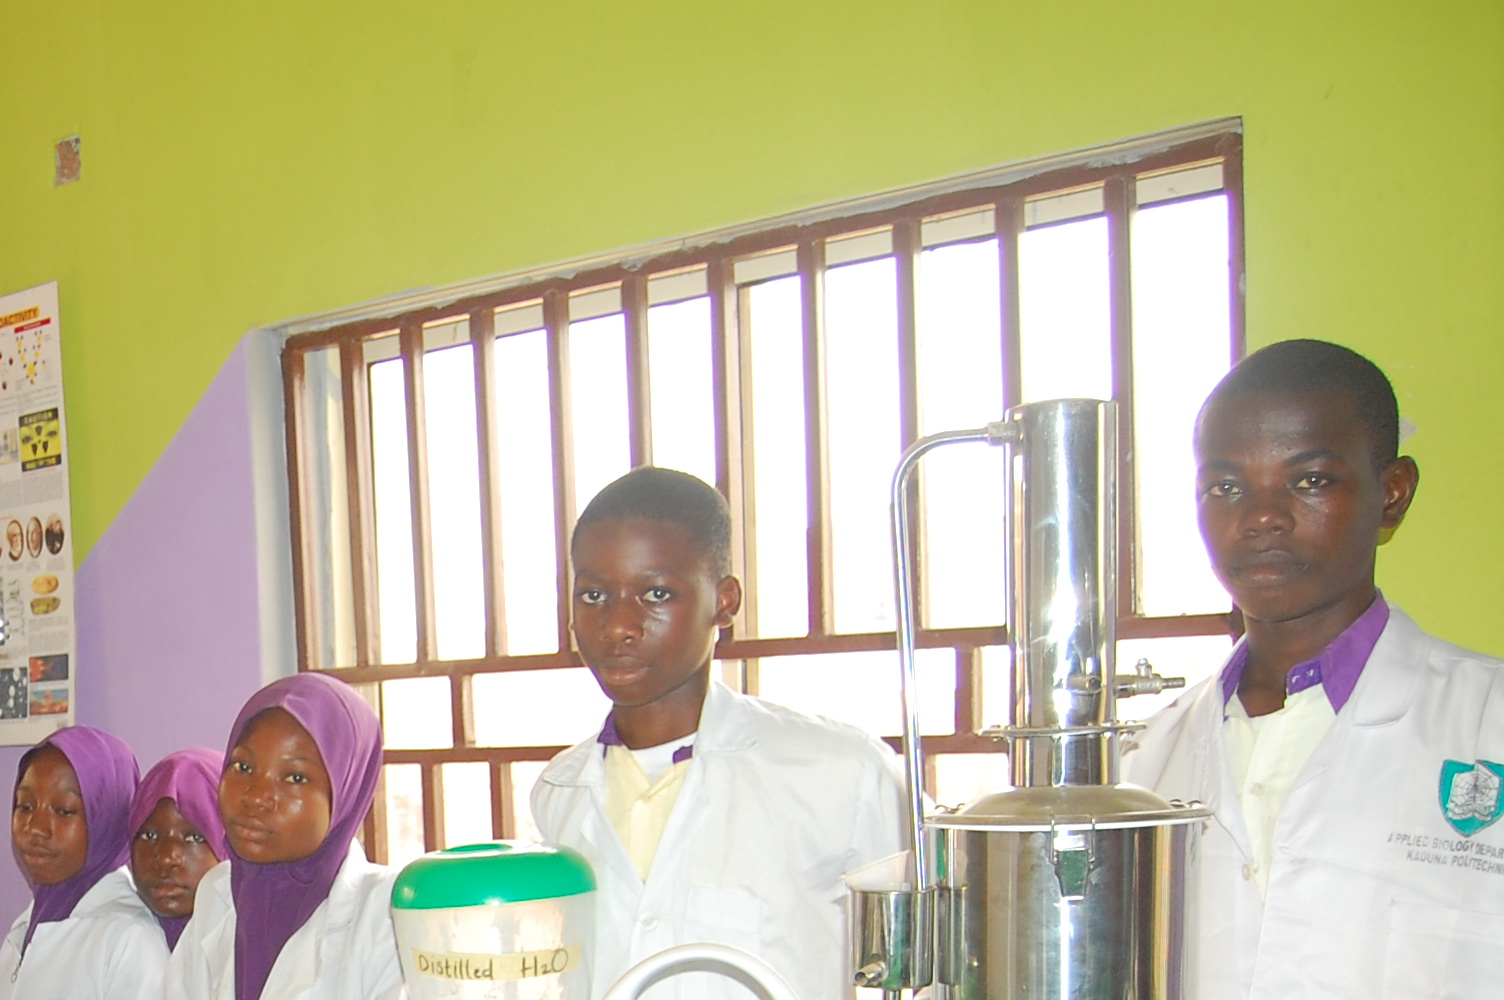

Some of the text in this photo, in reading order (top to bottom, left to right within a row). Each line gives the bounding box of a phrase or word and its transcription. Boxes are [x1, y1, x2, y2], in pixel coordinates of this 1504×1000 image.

[1387, 833, 1429, 847] APPLIED
[1432, 837, 1475, 852] BIOLOGY
[1407, 850, 1448, 865] KADUNA
[418, 949, 569, 980] Distilled H2O
